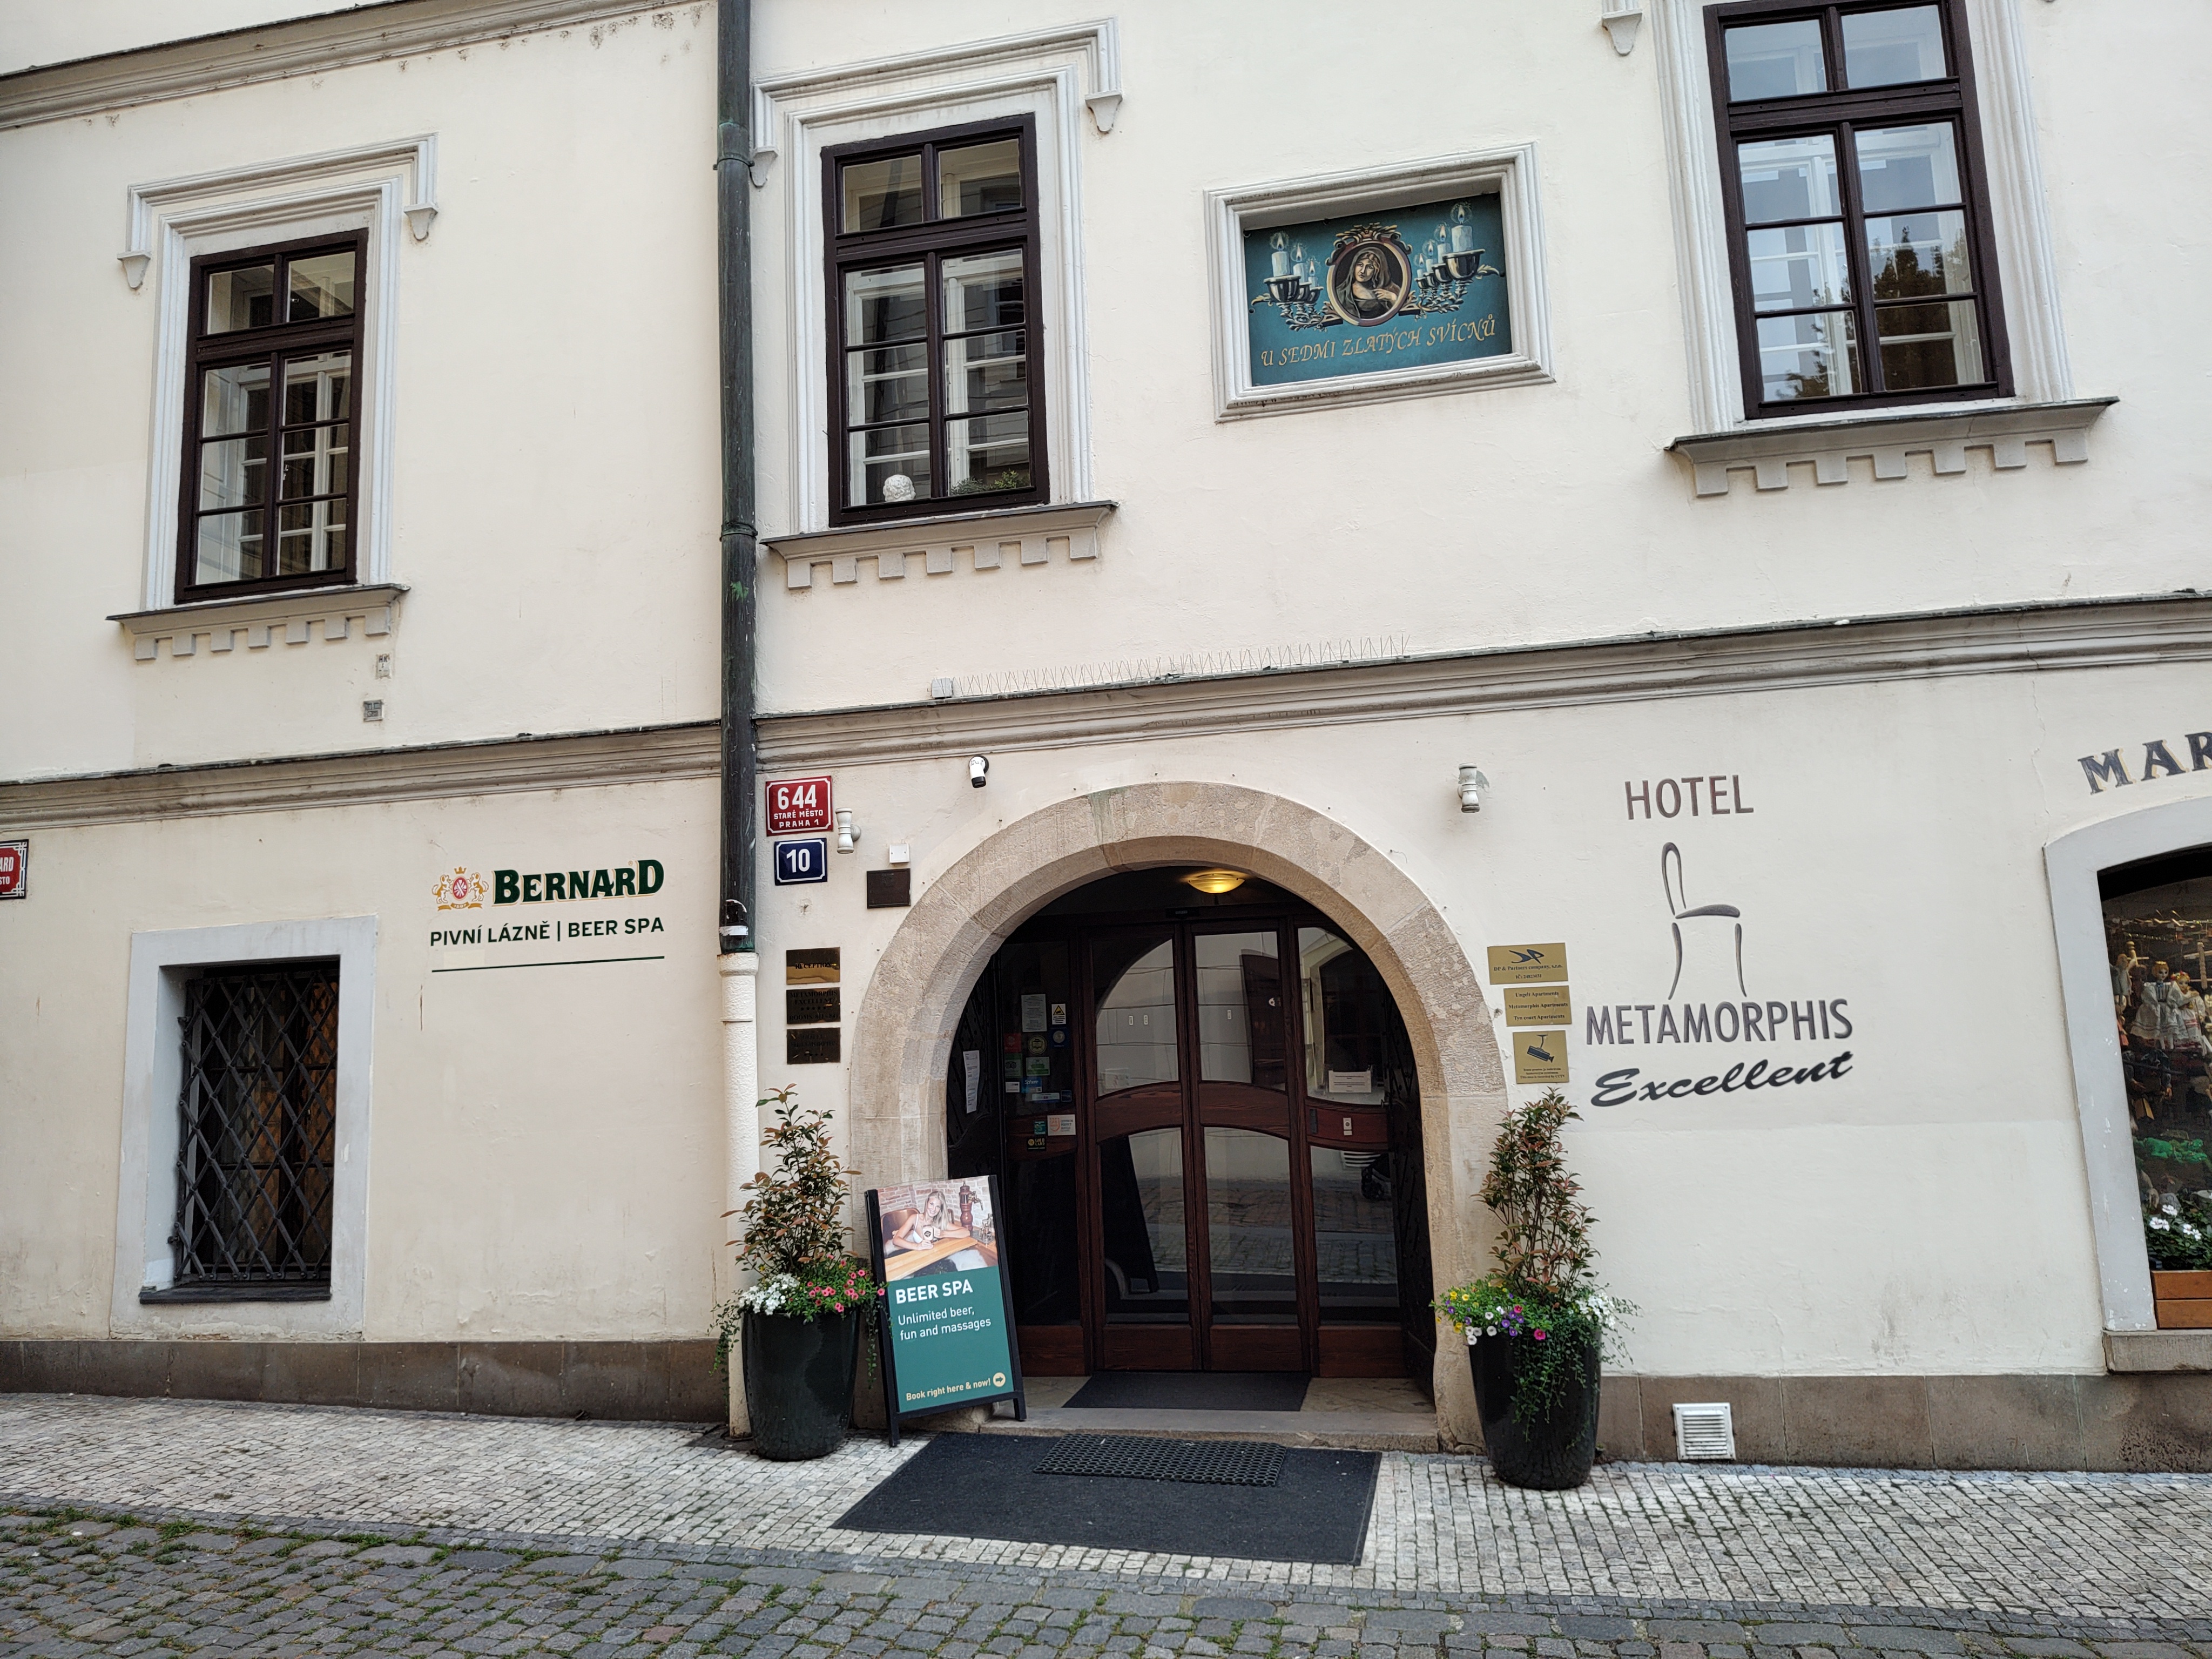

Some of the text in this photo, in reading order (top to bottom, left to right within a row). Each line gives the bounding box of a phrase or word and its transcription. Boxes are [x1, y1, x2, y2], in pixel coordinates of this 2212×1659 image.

[1262, 314, 1496, 366] U SEDMI ZLATÝCH SVÍCNŮ
[778, 785, 817, 810] 644
[1624, 774, 1754, 820] HOTEL
[774, 808, 823, 819] STARÉ MĚSTO
[779, 820, 810, 828] PRAHA
[786, 848, 810, 873] 10
[491, 859, 664, 907] BERNARD
[430, 916, 664, 946] PIVNÍ LÁZNĚ BEER SPA
[1586, 998, 1852, 1045] METAMORPHIS
[1590, 1051, 1854, 1107] Excellent
[895, 1279, 973, 1304] BEER SPA
[898, 1306, 974, 1326] Unlimited beer,
[900, 1318, 992, 1341] fun and massages
[906, 1391, 926, 1401] Book
[927, 1387, 945, 1398] right
[947, 1384, 964, 1393] here
[973, 1378, 991, 1388] now!
